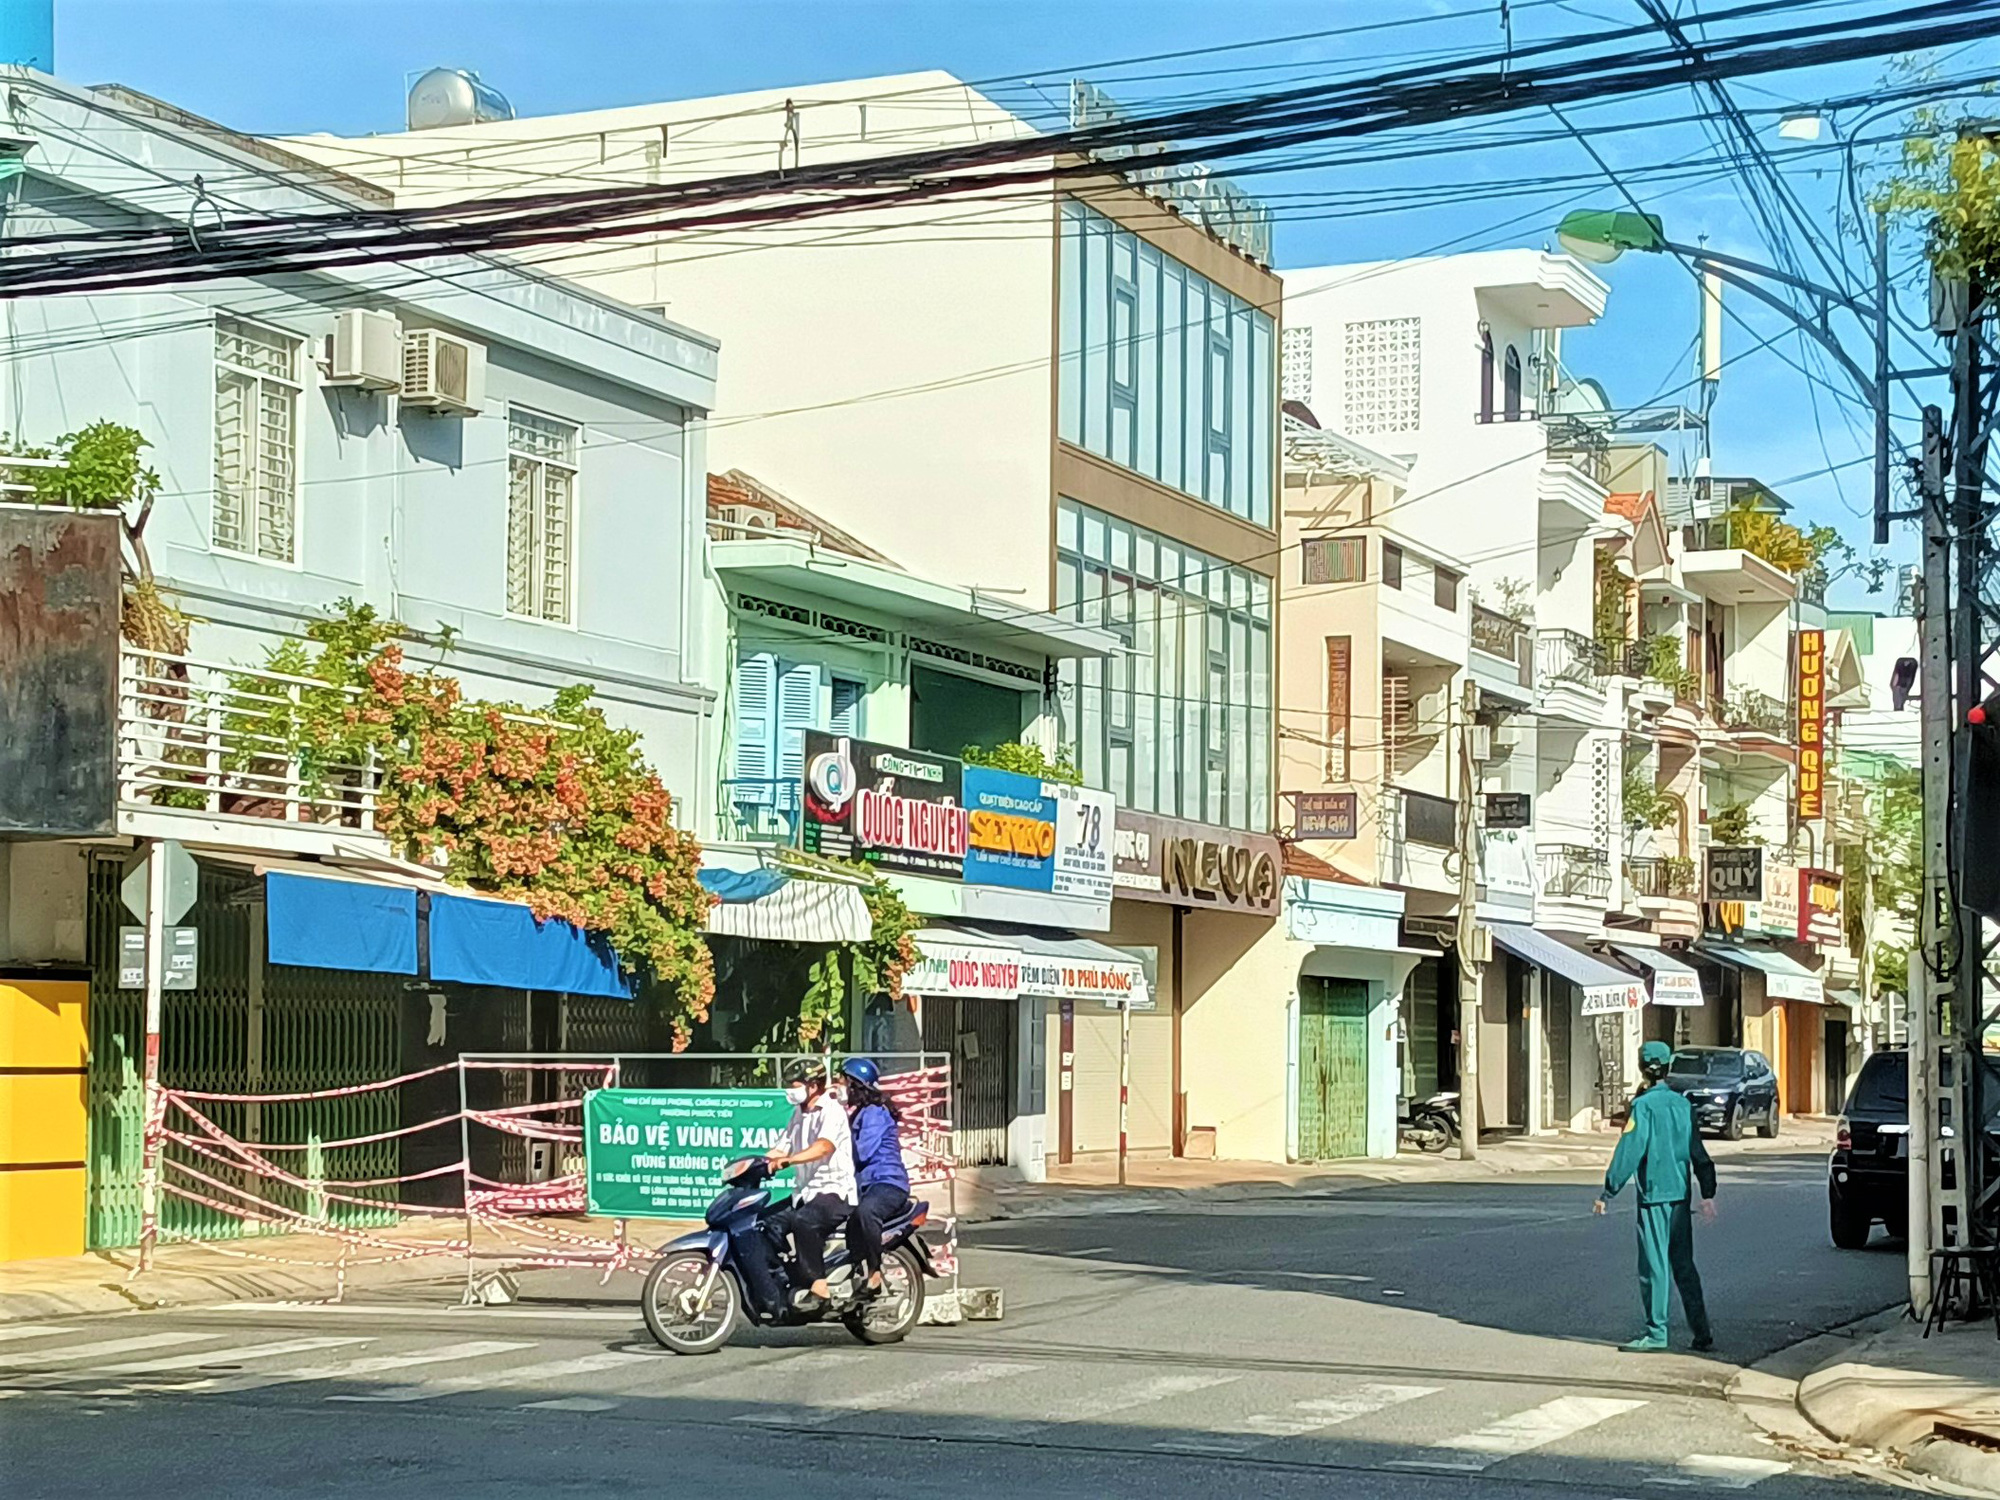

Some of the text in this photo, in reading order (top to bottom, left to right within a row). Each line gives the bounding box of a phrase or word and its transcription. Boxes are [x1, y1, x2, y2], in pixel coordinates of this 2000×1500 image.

[1800, 632, 1822, 816] HƯƠNG QUÊ
[862, 778, 904, 846] QUỐC
[1076, 803, 1102, 849] 78
[949, 950, 979, 988] QUỐC
[1061, 967, 1075, 988] 78
[599, 1116, 786, 1151] BẢO VỆ VÙNG XAN
[668, 1152, 709, 1170] KHÔNG
